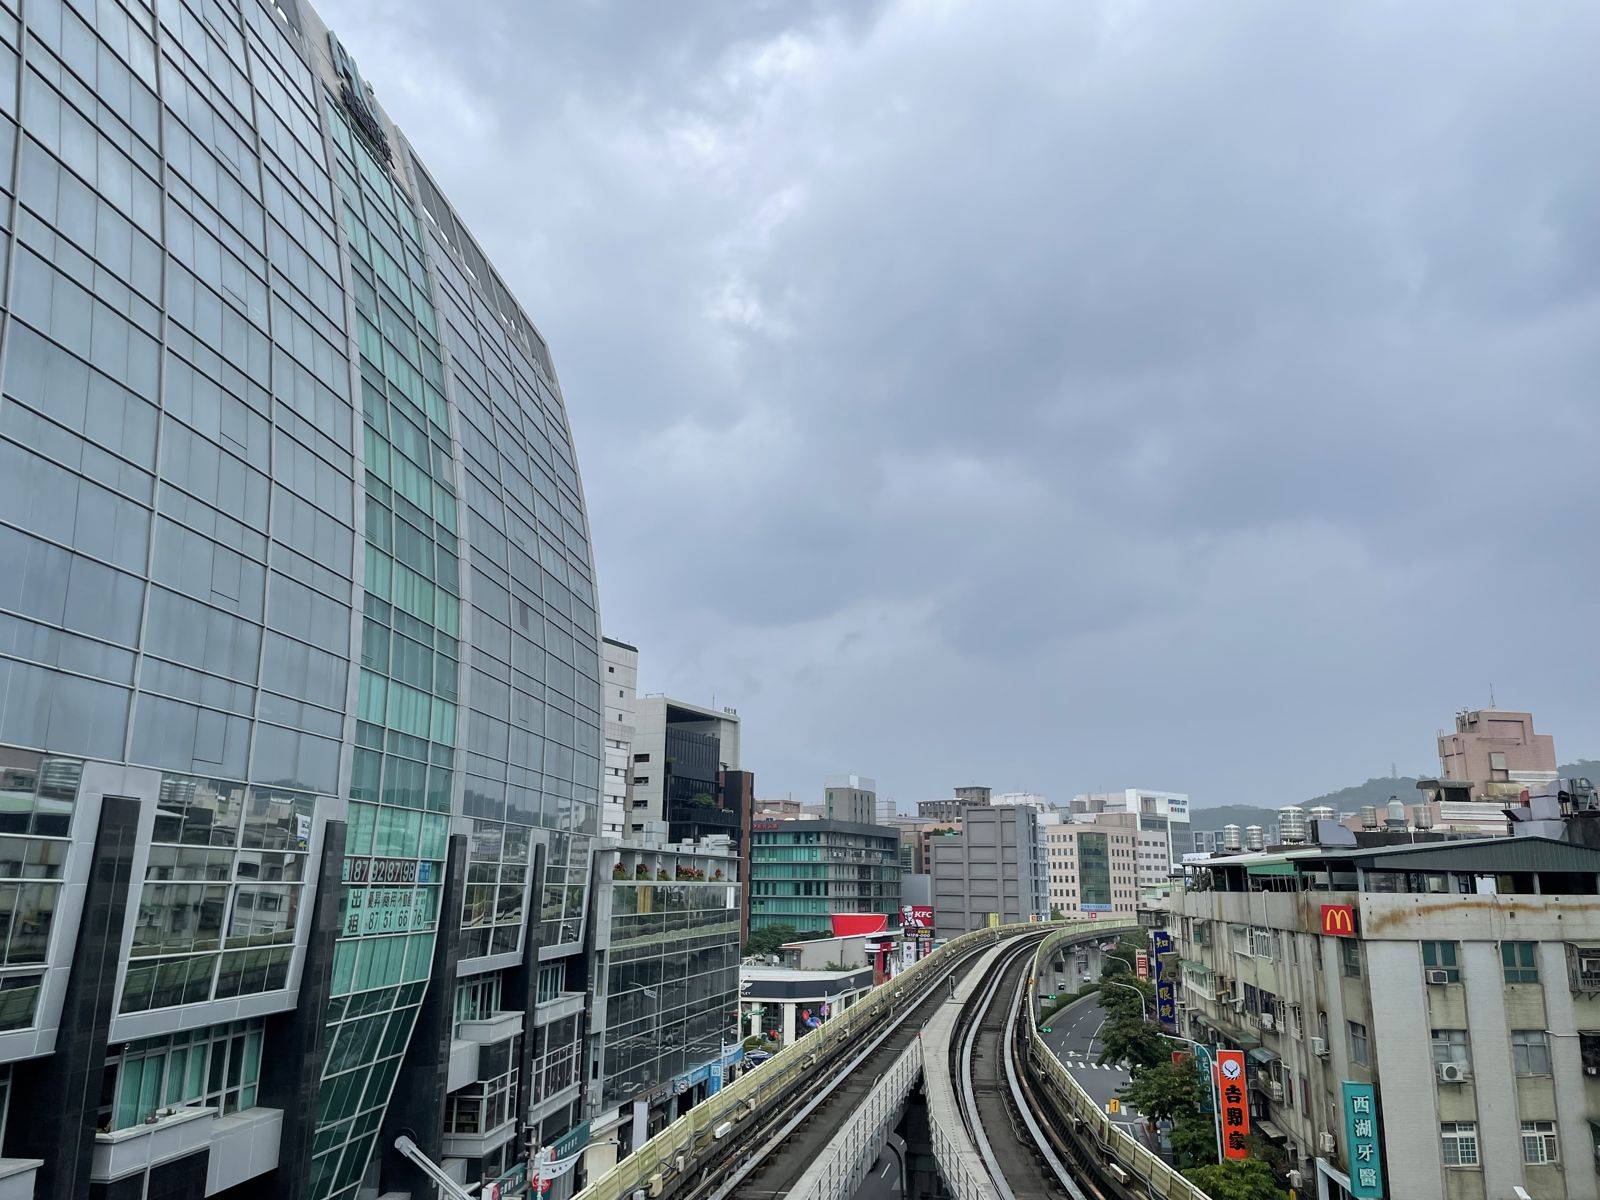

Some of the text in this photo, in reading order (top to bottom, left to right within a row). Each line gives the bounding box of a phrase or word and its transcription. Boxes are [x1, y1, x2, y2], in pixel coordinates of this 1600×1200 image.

[1225, 1084, 1246, 1151] 吉野家
[1351, 1095, 1377, 1188] 西湖牙醫
